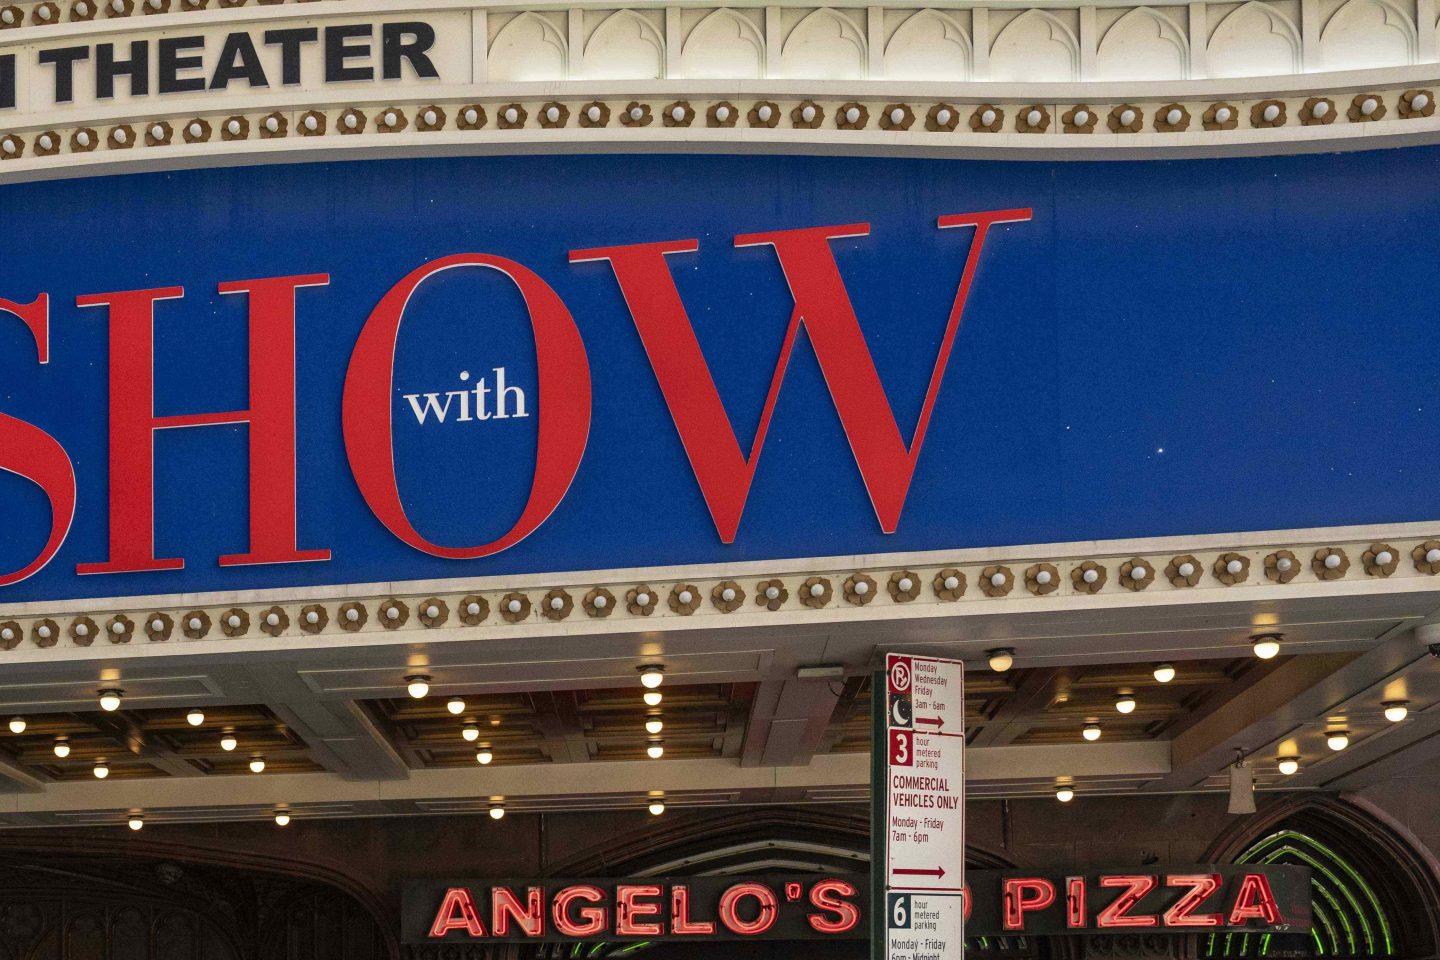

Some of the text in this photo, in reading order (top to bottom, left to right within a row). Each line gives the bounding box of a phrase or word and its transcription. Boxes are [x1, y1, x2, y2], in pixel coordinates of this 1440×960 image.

[38, 21, 440, 103] THEATER
[402, 366, 530, 426] with
[914, 662, 938, 674] Monday
[914, 674, 948, 688] Wednesday
[914, 685, 933, 697] Friday
[915, 699, 928, 709] 3am
[932, 701, 946, 711] 6am
[895, 733, 908, 764] 3
[916, 737, 930, 747] hour
[916, 748, 941, 758] metered
[916, 759, 939, 770] parking
[893, 775, 950, 791] COMMERCIAL
[893, 793, 959, 809] VEHICLES ONLY
[892, 816, 918, 830] Monday
[923, 817, 945, 831] Friday
[892, 830, 907, 842] 7am
[913, 832, 929, 844] 6pm
[430, 880, 859, 937] ANGELO'S
[914, 899, 928, 909] hour
[1002, 873, 1282, 930] PIZZA
[893, 896, 907, 927] 6
[914, 910, 940, 920] metered
[914, 920, 937, 931] parking
[891, 939, 919, 951] Monday
[924, 939, 946, 952] Friday
